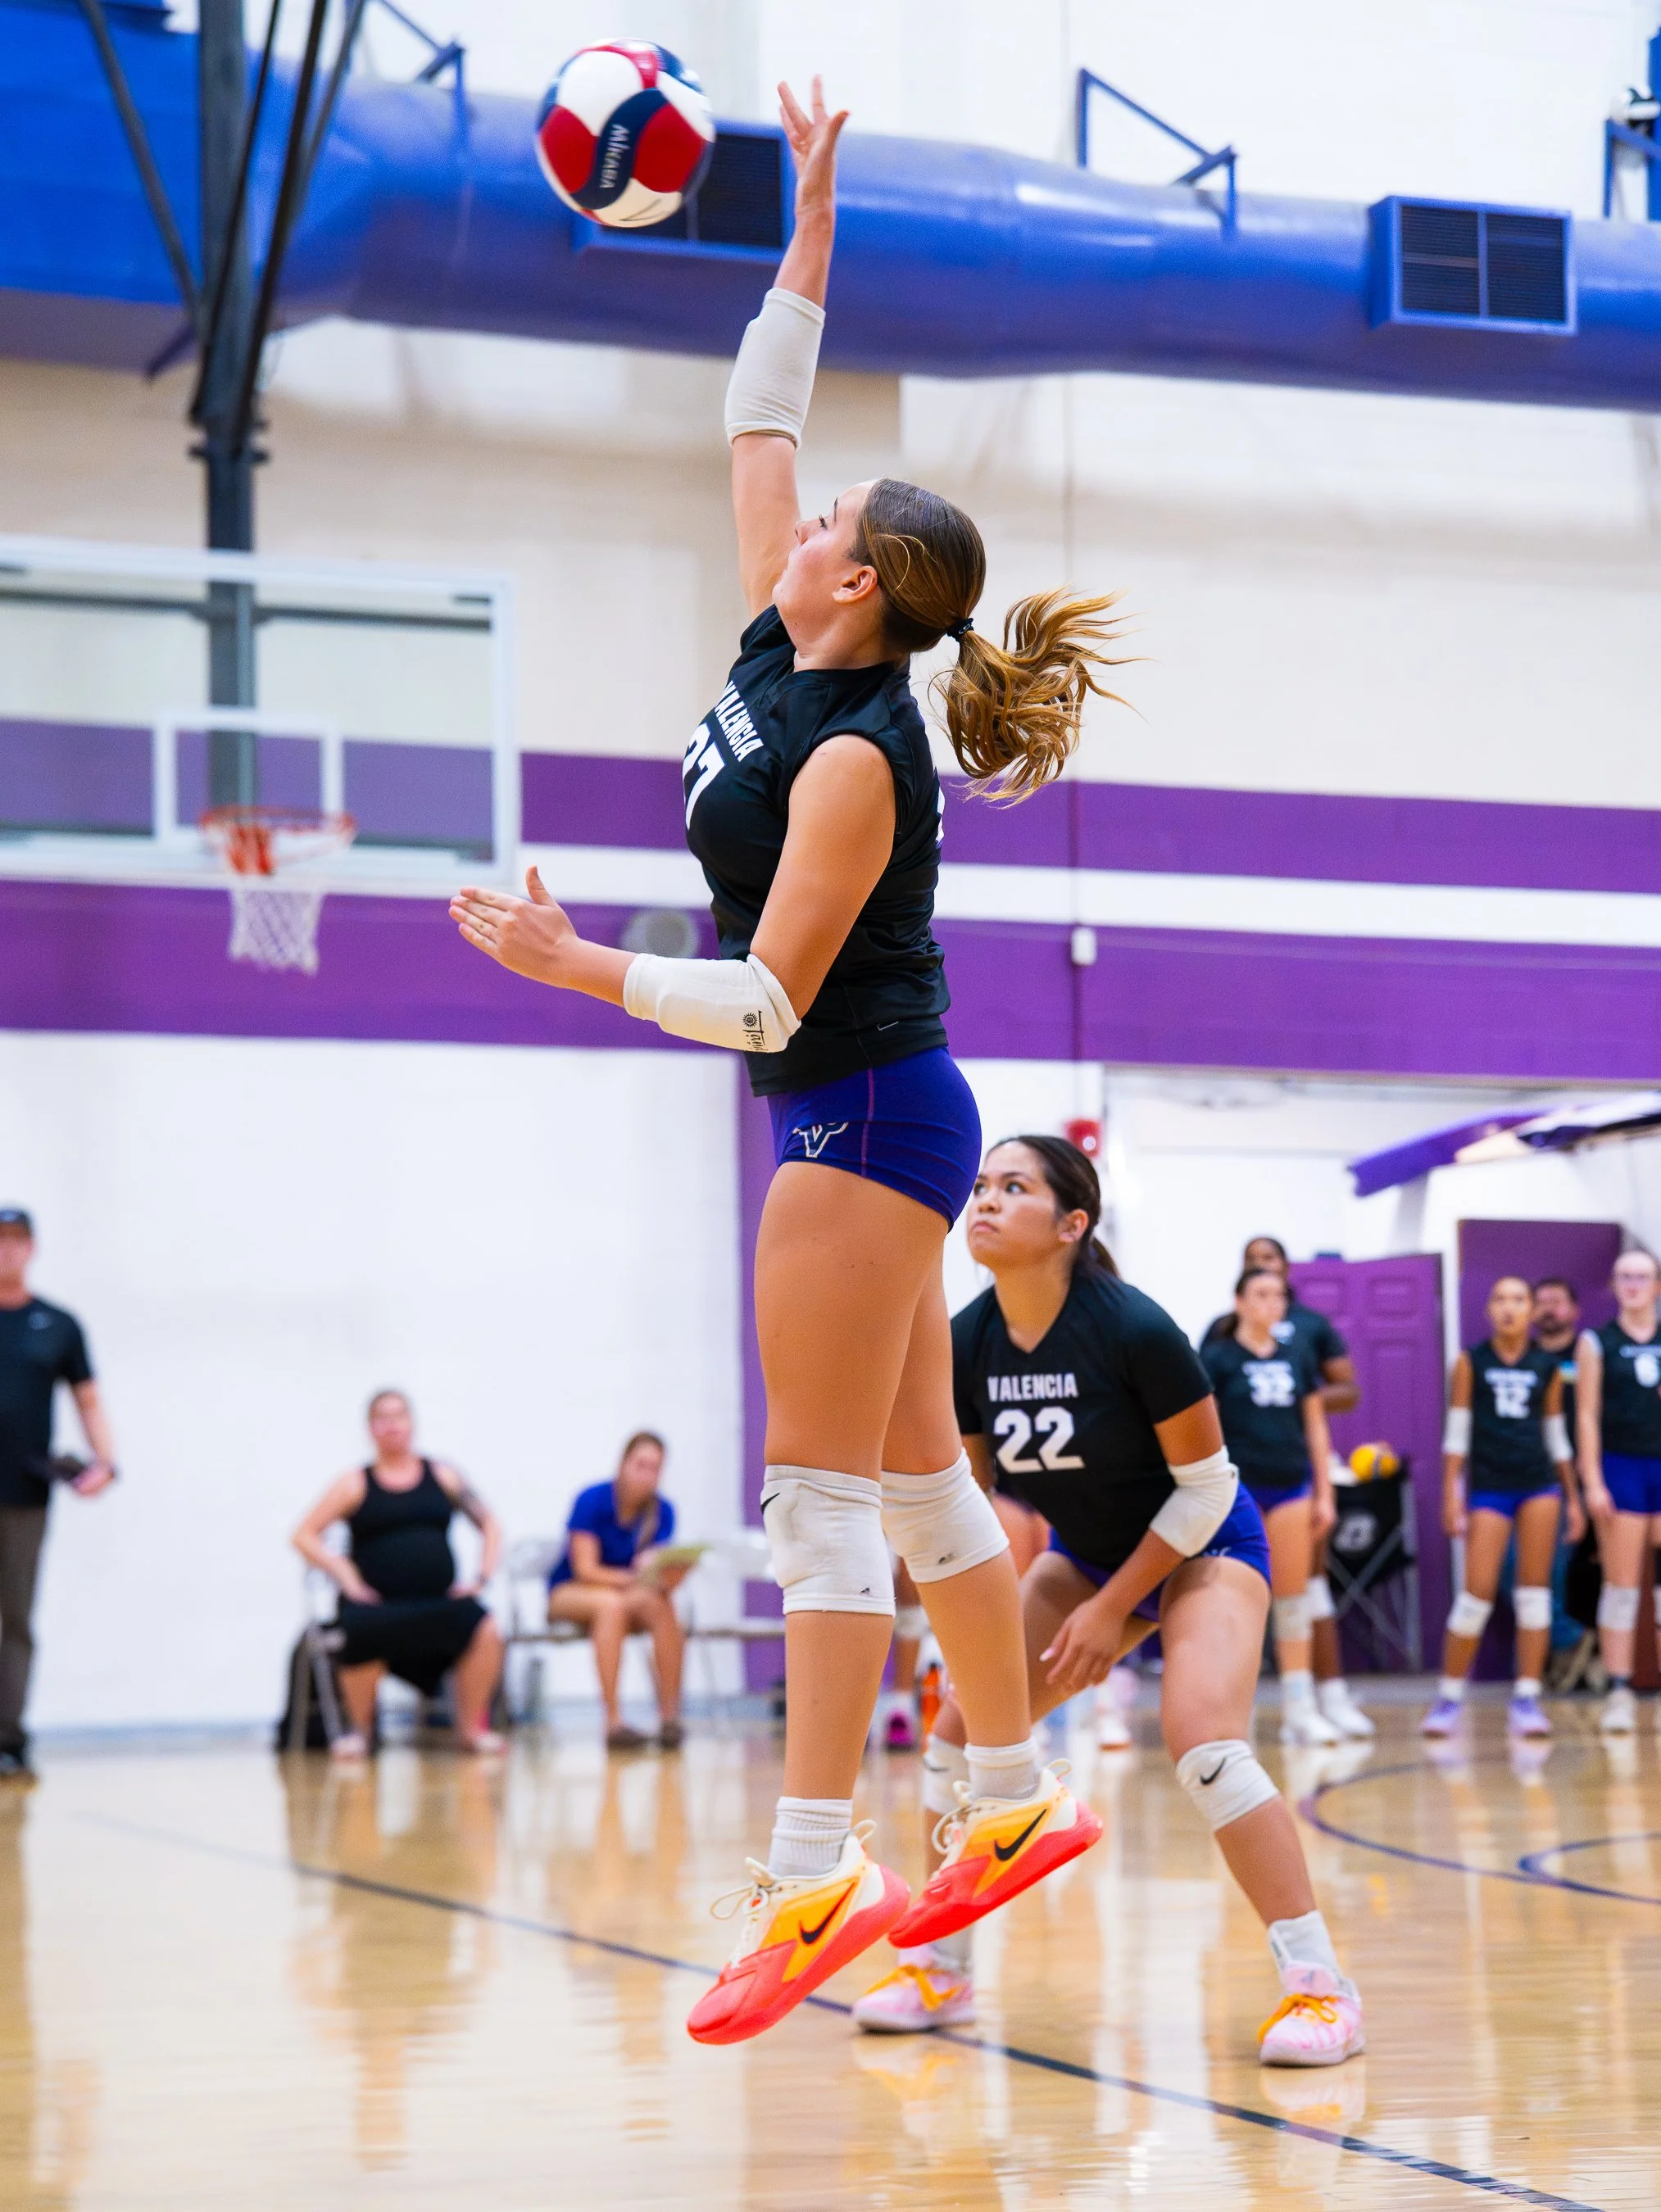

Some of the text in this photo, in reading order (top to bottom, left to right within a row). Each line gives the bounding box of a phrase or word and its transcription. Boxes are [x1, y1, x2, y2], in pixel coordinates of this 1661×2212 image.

[715, 680, 764, 762] VALENCIA
[987, 1372, 1078, 1402] VALENCIA
[994, 1406, 1086, 1474] 22
